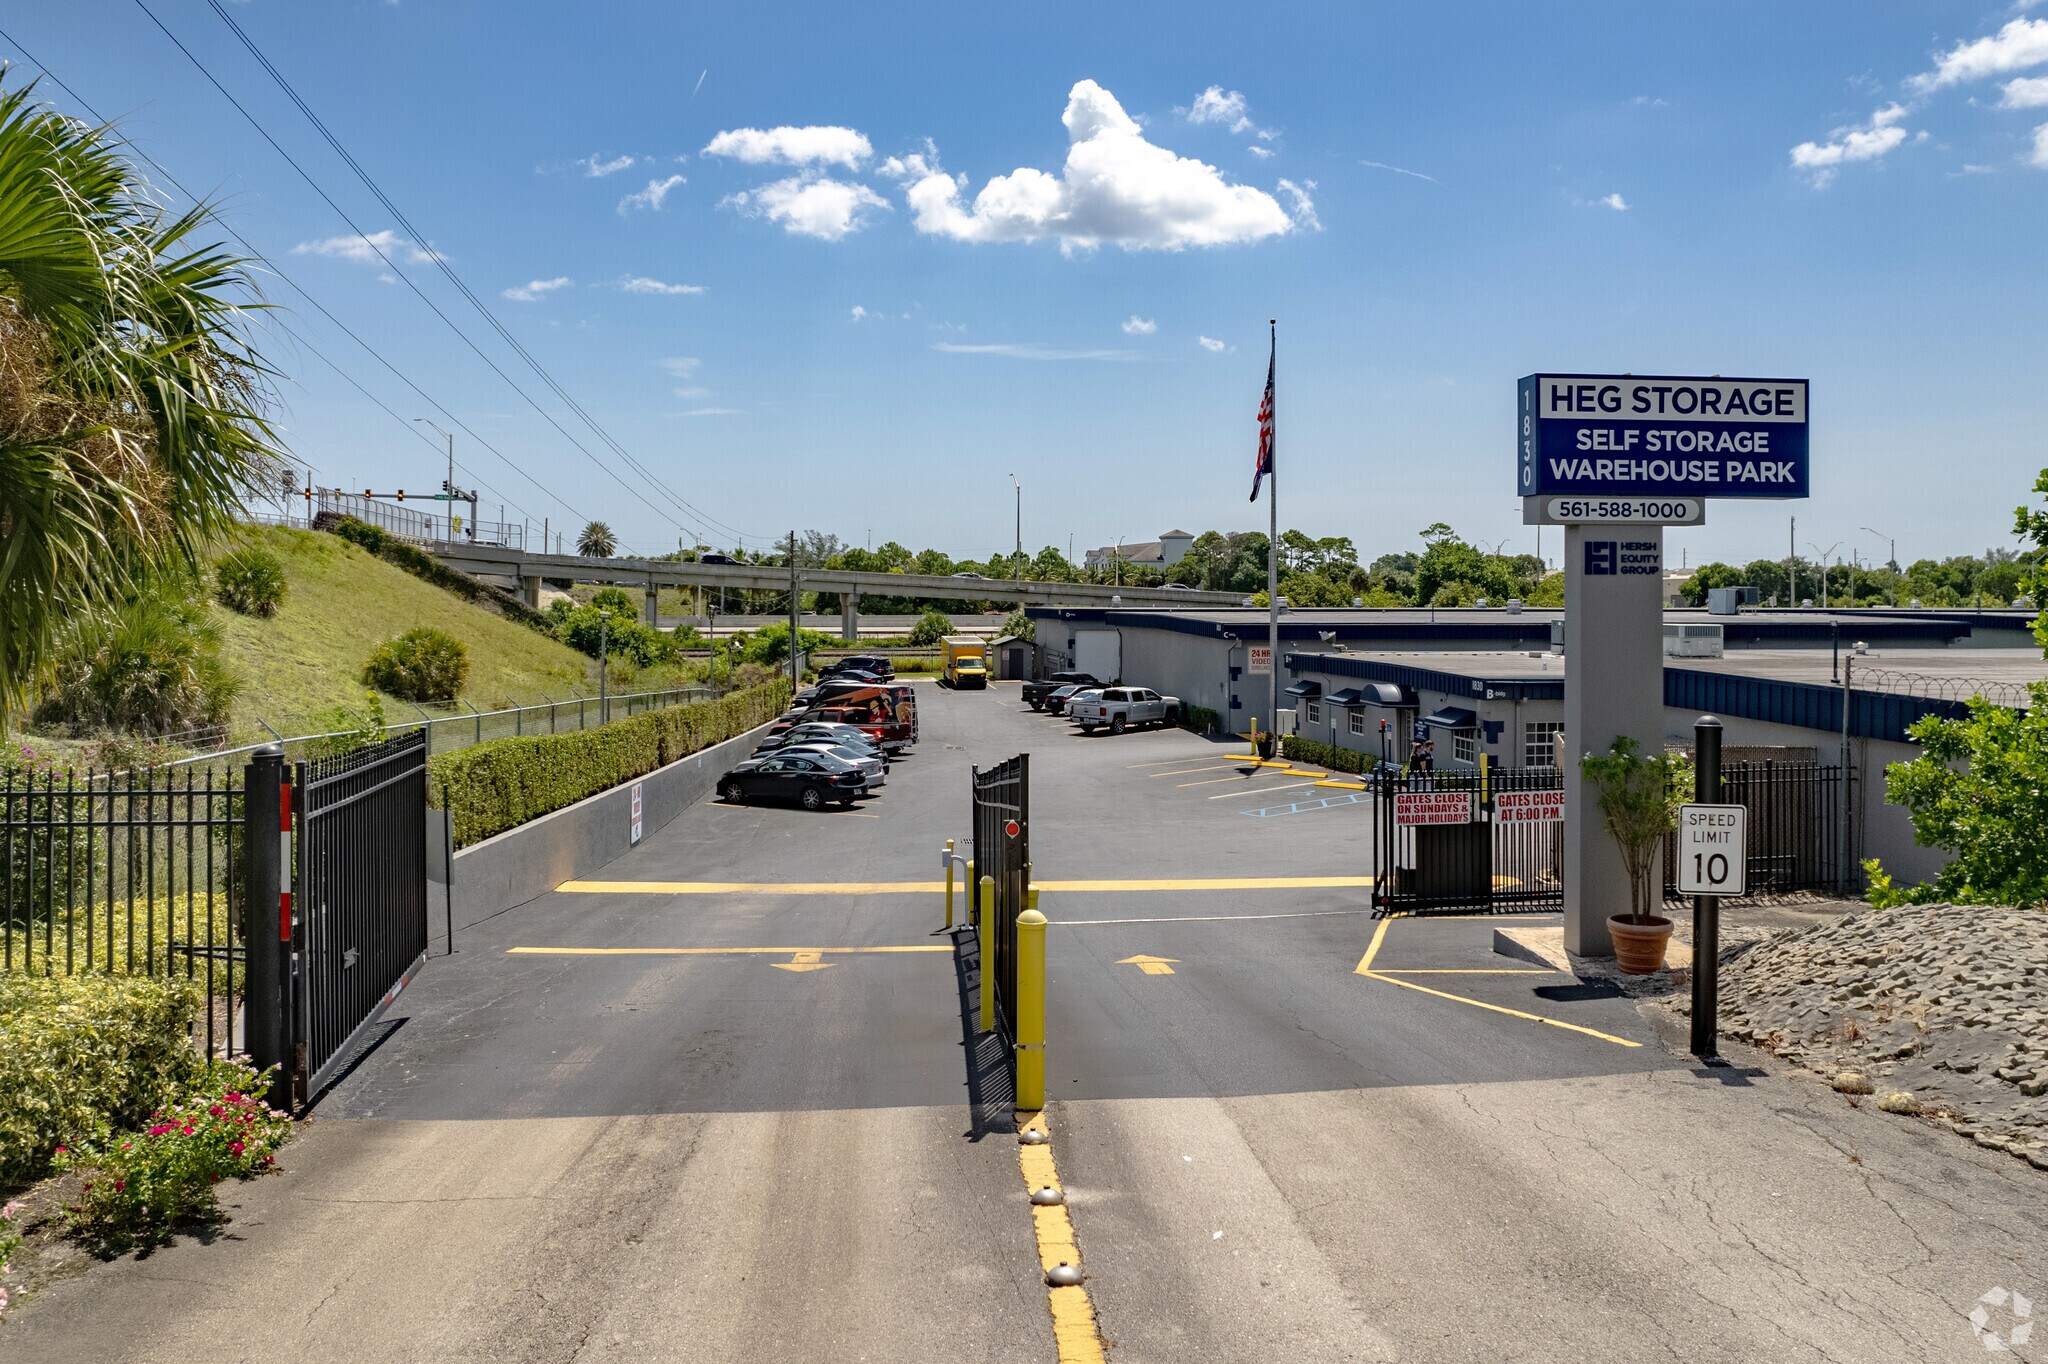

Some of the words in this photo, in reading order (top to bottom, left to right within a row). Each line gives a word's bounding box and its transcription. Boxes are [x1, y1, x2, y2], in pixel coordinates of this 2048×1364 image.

[1551, 384, 1622, 413] HEG
[1631, 386, 1795, 416] STORAGE
[1523, 390, 1531, 487] 1830
[1576, 429, 1640, 451] SELF
[1645, 430, 1769, 453] STORAGE
[1549, 458, 1720, 482] WAREHOUSE
[1726, 461, 1796, 483] PARK
[1559, 501, 1687, 518] 561-588-1000
[1620, 542, 1657, 551] HERSH
[1620, 554, 1659, 563] EQUITY
[1620, 566, 1659, 575] GROUP
[1251, 649, 1260, 657] 24
[1397, 794, 1432, 804] GATES
[1434, 793, 1469, 804] CLOSE
[1498, 794, 1531, 807] GATES
[1533, 792, 1565, 806] CLOSE
[1397, 804, 1411, 814] ON
[1413, 803, 1459, 814] SUNDAYS
[1461, 804, 1469, 813] &
[1501, 808, 1514, 821] AT
[1516, 807, 1540, 820] 6:00
[1542, 806, 1563, 819] P.M.
[1397, 814, 1427, 824] MAJOR
[1428, 813, 1469, 823] HOLIDAYS
[1689, 813, 1736, 827] SPEED
[1693, 830, 1731, 843] LIMIT
[1694, 853, 1729, 885] 10
